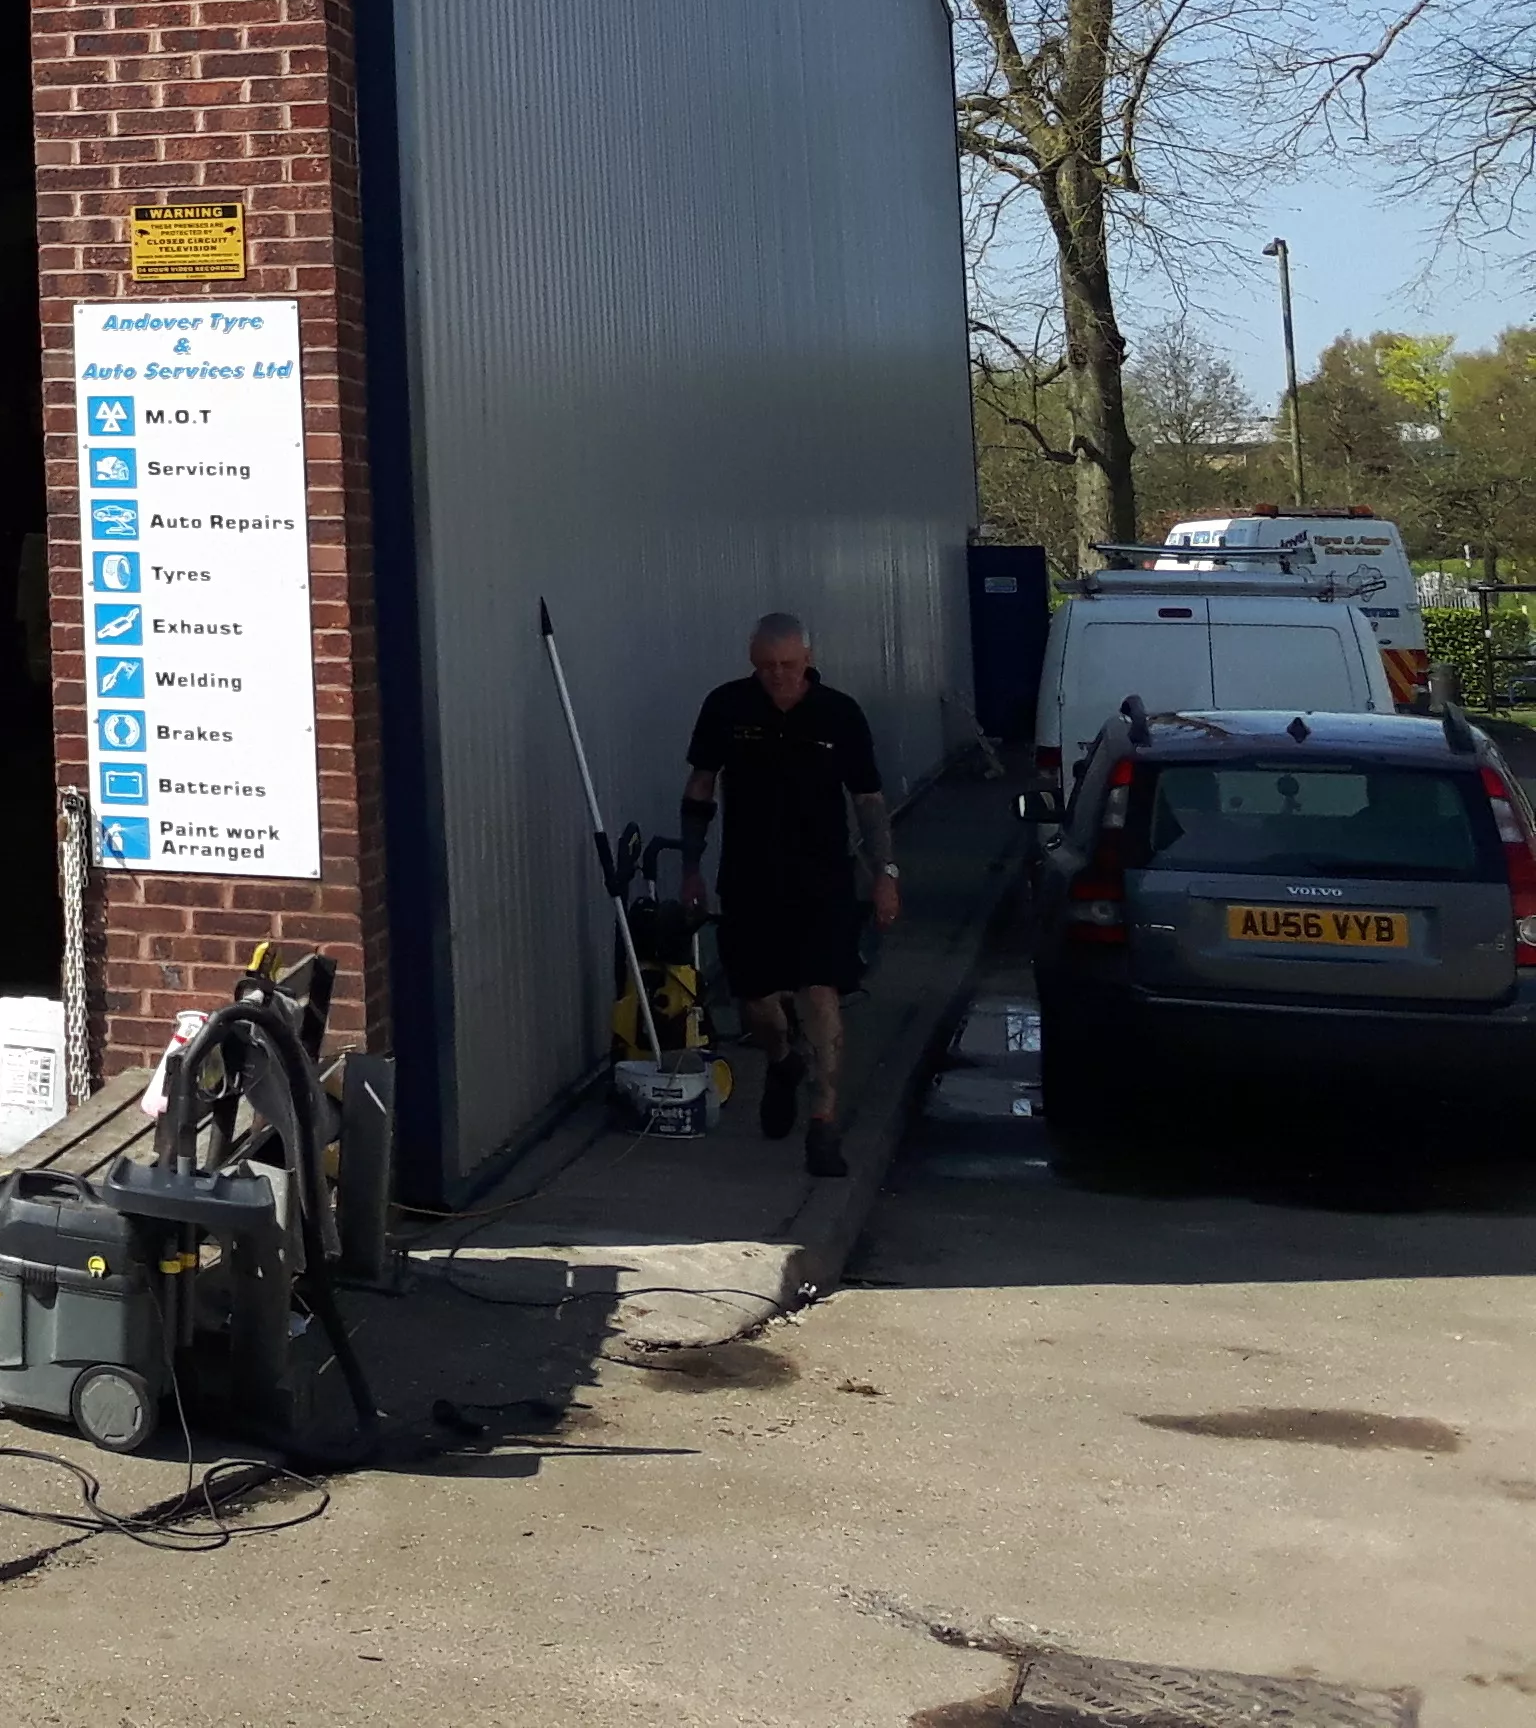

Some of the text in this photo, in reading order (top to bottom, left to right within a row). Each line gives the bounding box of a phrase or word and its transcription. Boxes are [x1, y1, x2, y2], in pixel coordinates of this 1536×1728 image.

[149, 207, 223, 219] WARNING
[147, 237, 228, 246] CLOSED CIRCUIT
[159, 245, 217, 253] TELEVISION
[101, 313, 264, 334] Andover Tyre
[173, 337, 192, 355] &
[81, 360, 293, 380] Auto Services Ltd
[145, 409, 211, 425] M.O.T
[147, 461, 251, 481] Servicing
[150, 514, 295, 533] Auto Repairs
[151, 566, 212, 583] Tyres
[152, 618, 243, 636] Exhaust
[155, 672, 242, 692] Welding
[156, 725, 234, 743] Brakes
[158, 778, 266, 798] Batteries
[160, 820, 281, 841] Paint work
[161, 839, 265, 860] Arranged
[1286, 885, 1343, 897] VOLVO
[1241, 907, 1395, 943] AU56 VYB
